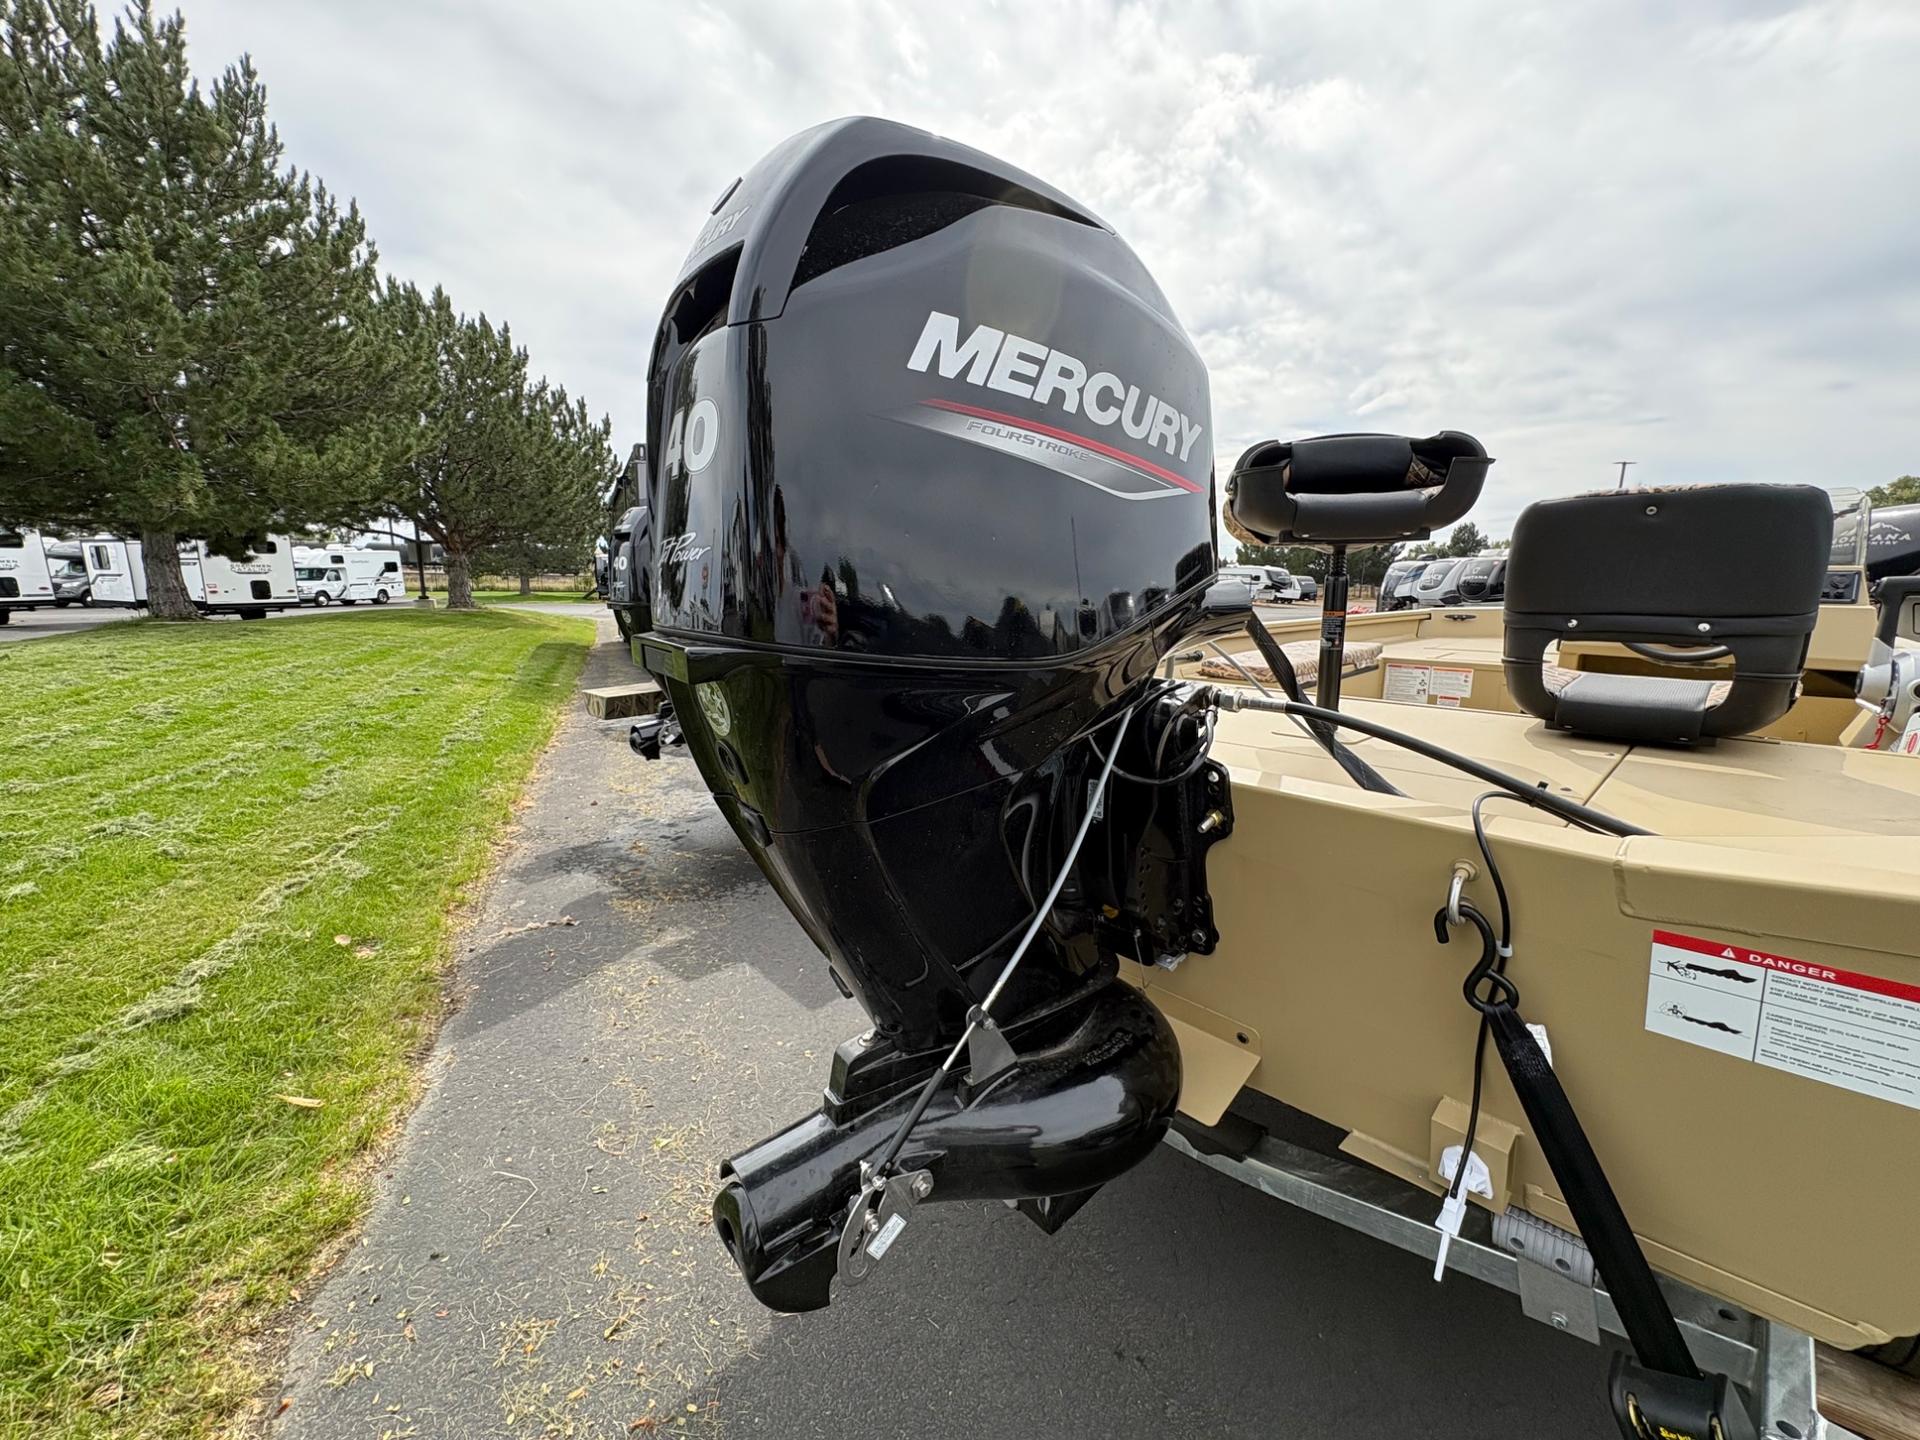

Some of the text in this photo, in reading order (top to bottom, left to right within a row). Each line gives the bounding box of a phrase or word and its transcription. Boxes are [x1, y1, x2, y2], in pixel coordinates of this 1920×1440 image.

[907, 310, 1202, 462] MERCURY
[664, 397, 720, 481] 40
[966, 420, 1092, 462] FOURSTROKE
[1749, 954, 1837, 980] DANGER
